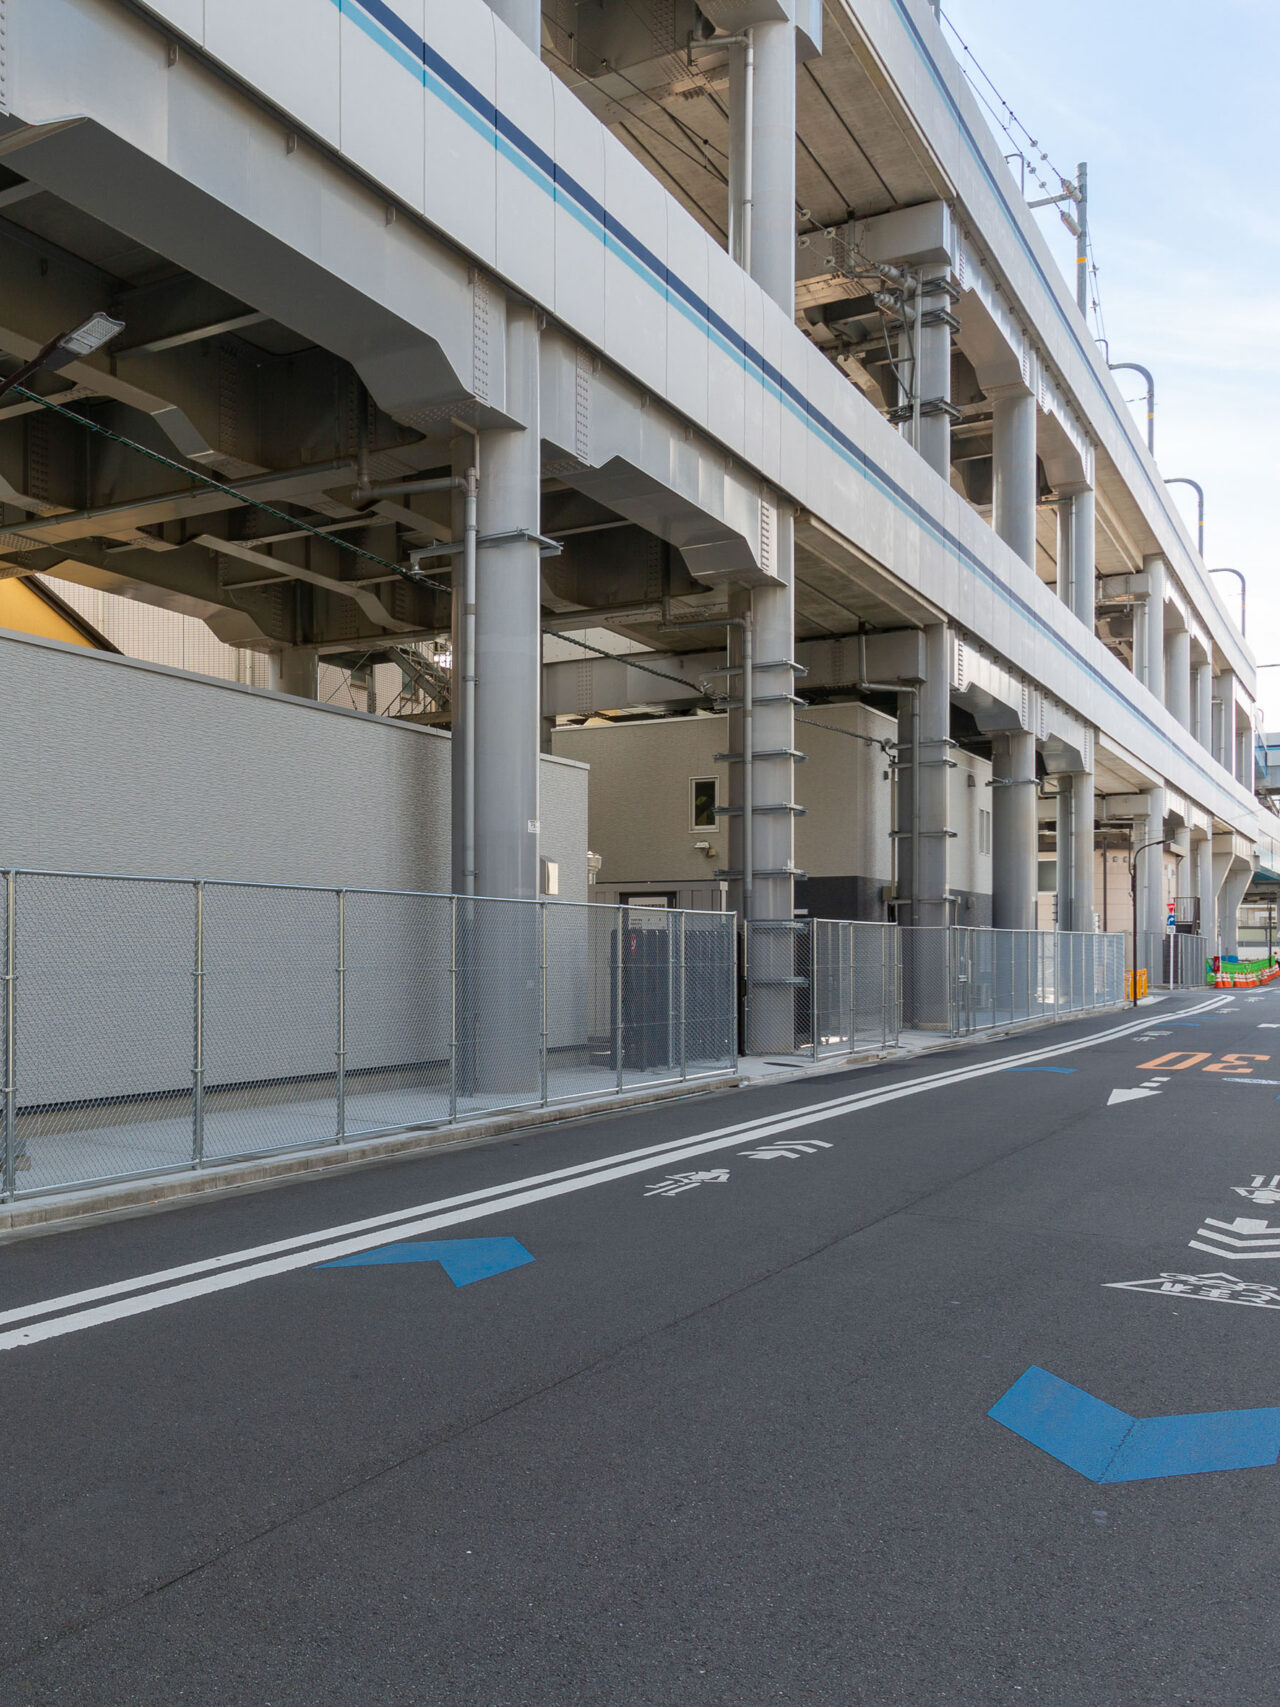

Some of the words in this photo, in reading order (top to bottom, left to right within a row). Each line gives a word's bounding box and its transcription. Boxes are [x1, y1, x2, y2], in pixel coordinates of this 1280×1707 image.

[1136, 1051, 1271, 1074] 30
[1160, 1281, 1272, 1304] とまれ
